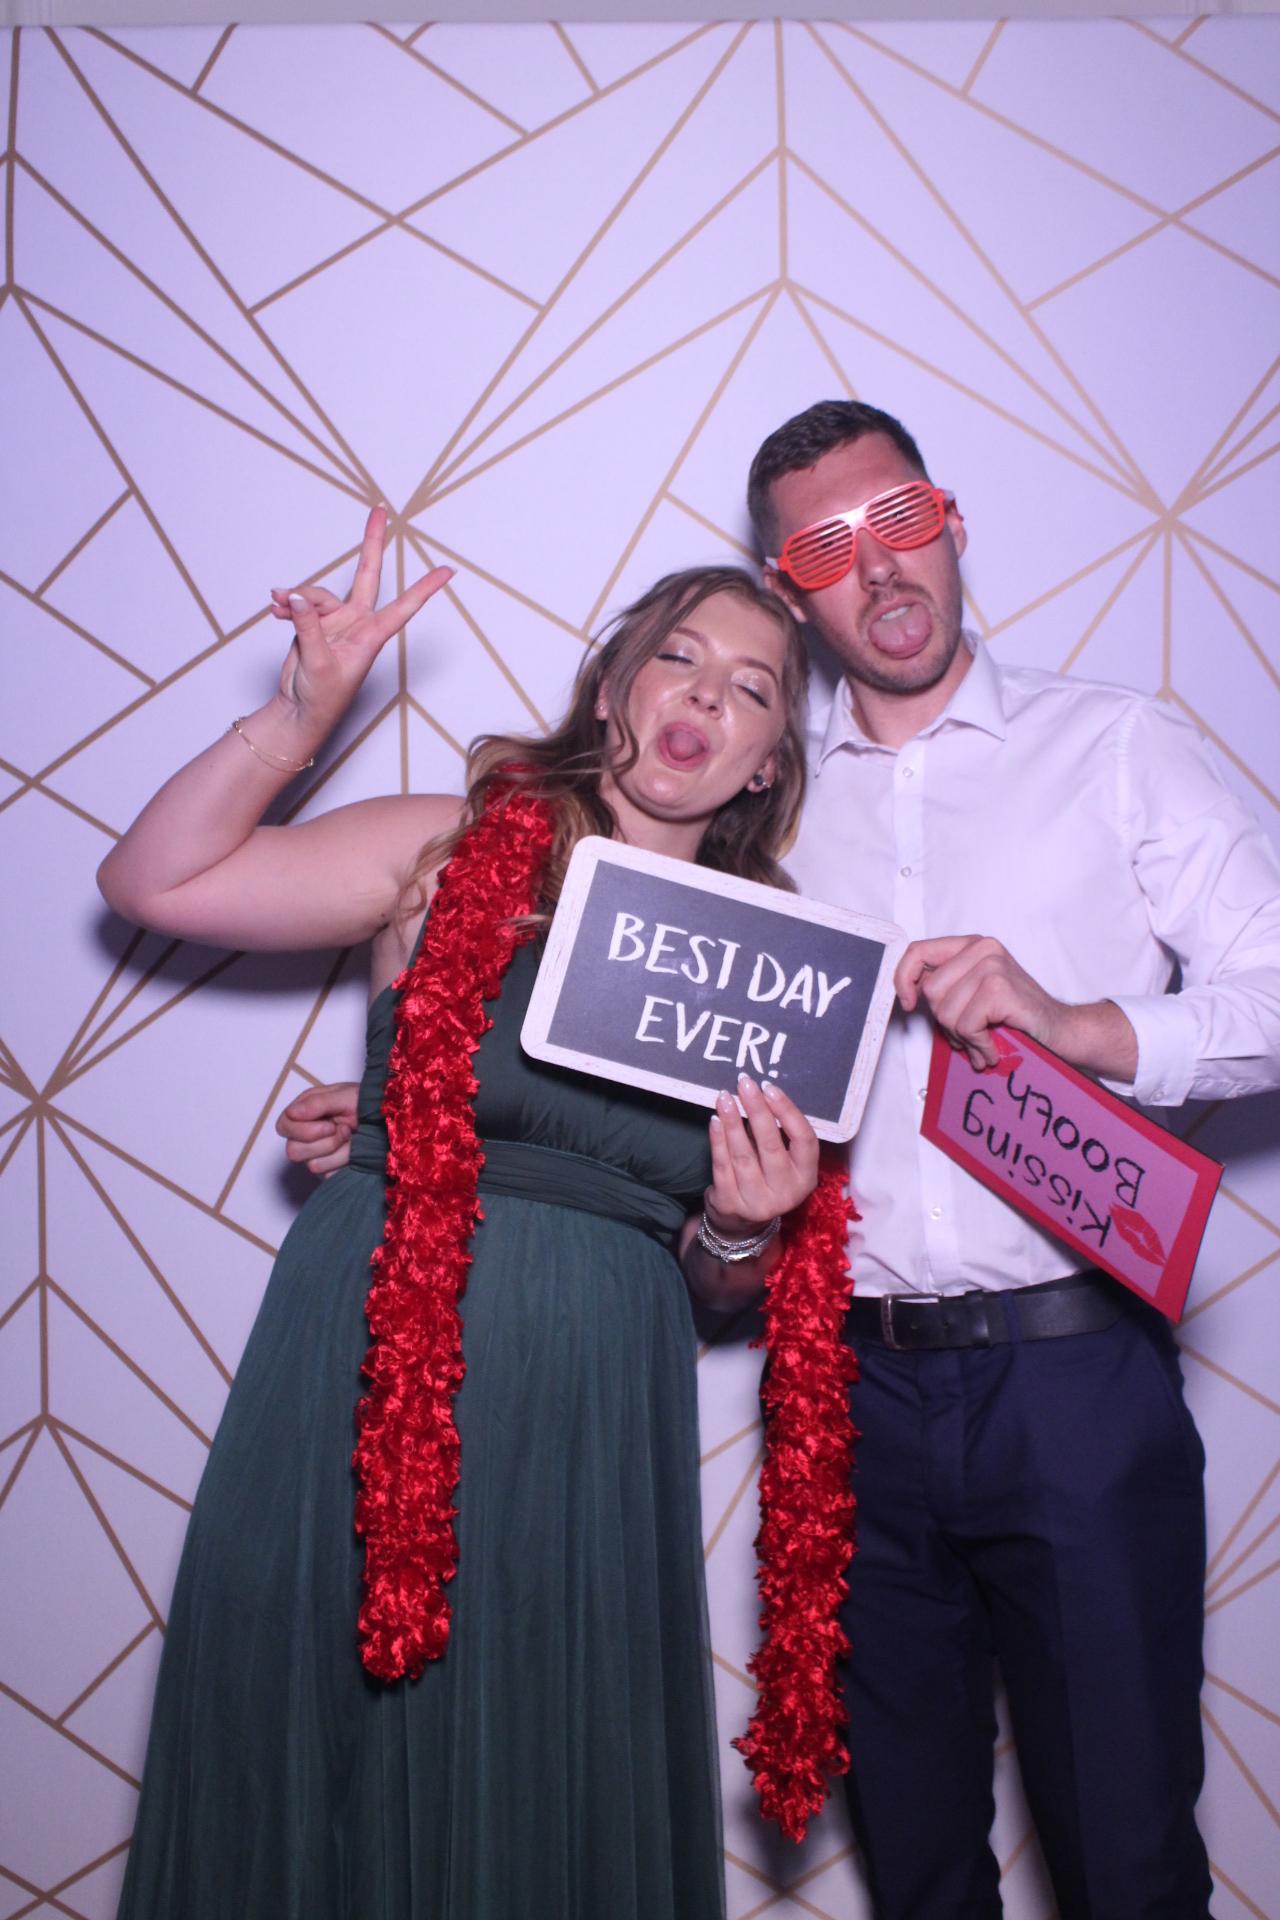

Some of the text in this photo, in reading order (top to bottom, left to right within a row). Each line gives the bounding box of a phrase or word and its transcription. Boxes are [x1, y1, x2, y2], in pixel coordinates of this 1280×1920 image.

[607, 911, 853, 1018] BEST DAY
[635, 995, 788, 1079] EVER!
[962, 1088, 1112, 1248] Kissing
[1006, 1070, 1146, 1209] Booth
